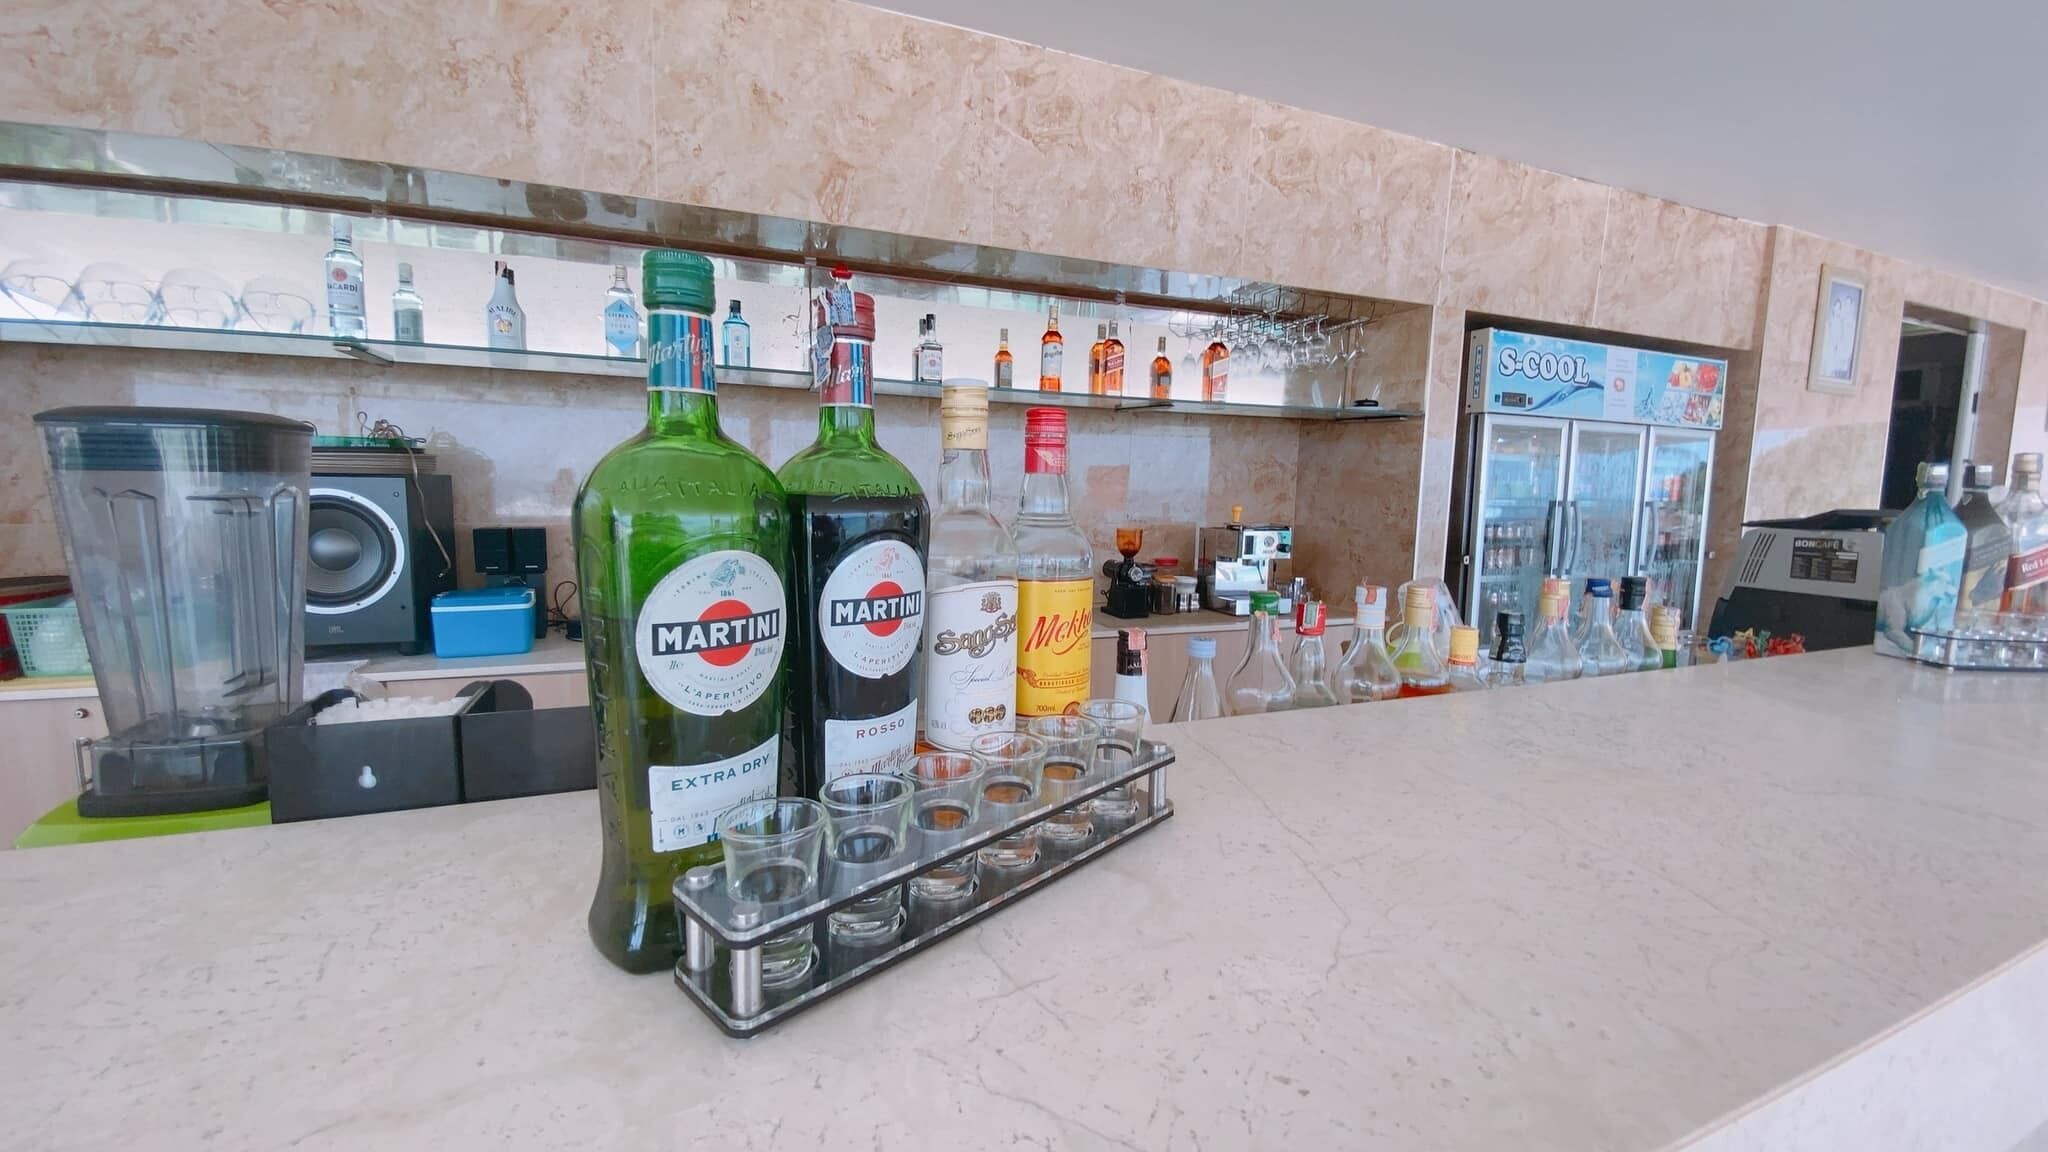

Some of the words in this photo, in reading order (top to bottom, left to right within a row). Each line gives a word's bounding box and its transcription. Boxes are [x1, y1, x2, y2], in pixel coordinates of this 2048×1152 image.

[1499, 347, 1591, 386] S-COOL
[835, 593, 920, 624] MARTINI
[658, 612, 778, 653] MARTINI
[856, 718, 905, 739] ROSSO
[671, 766, 737, 792] EXTRA
[742, 753, 770, 774] DRY
